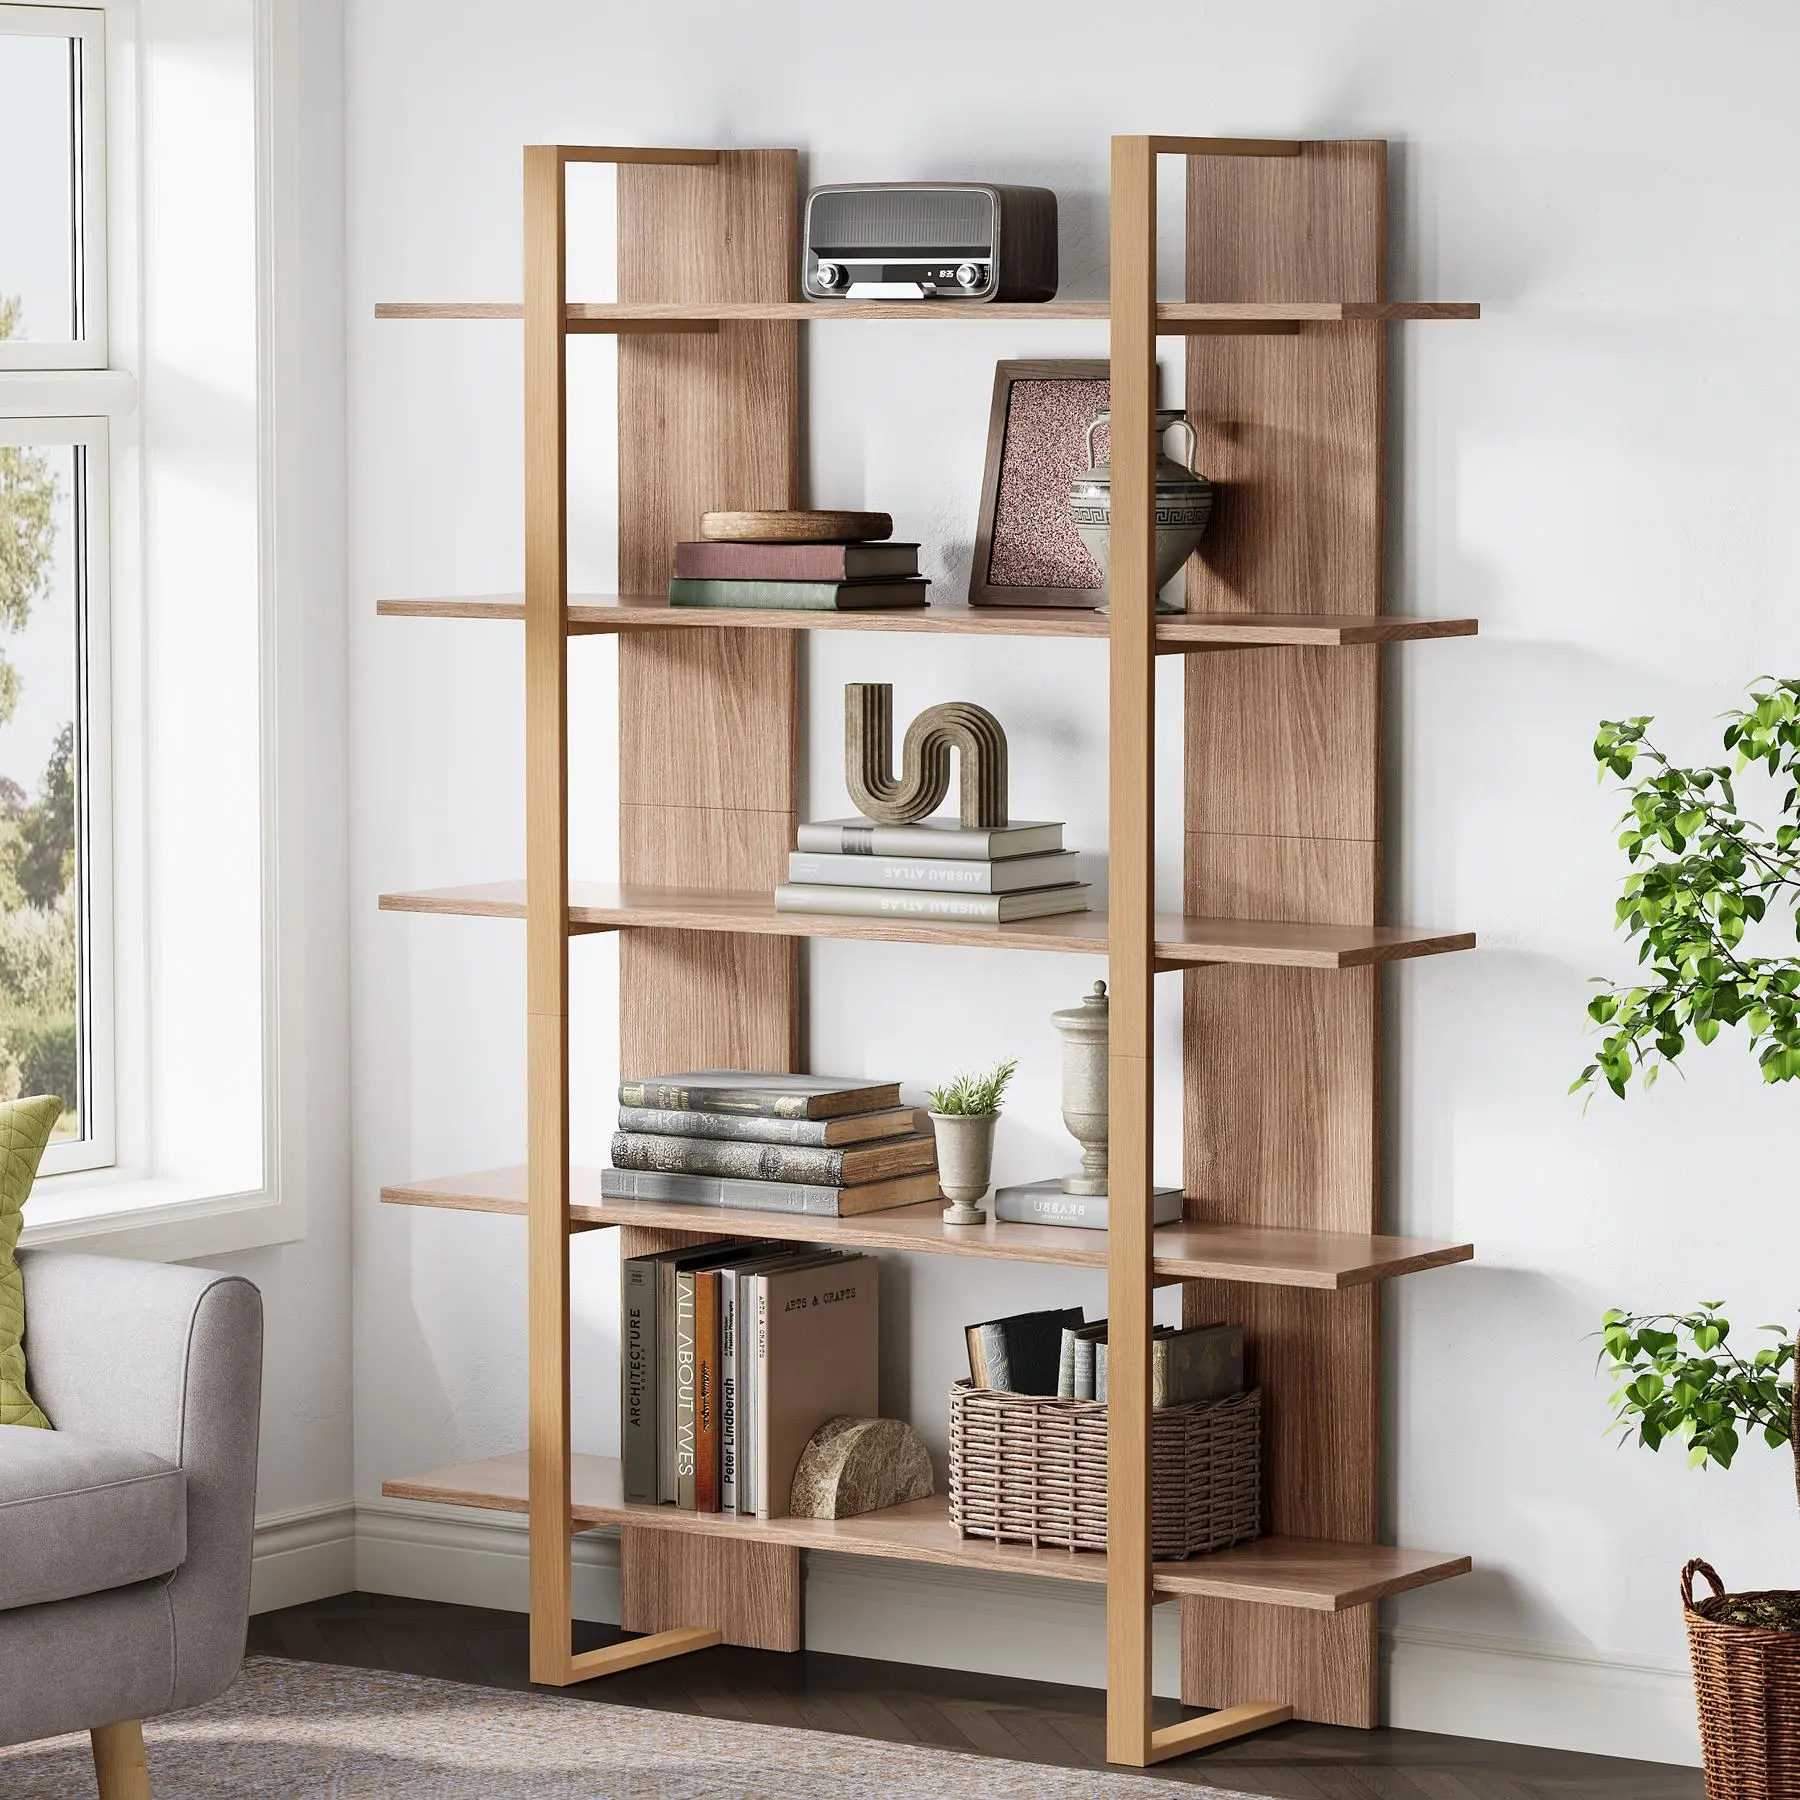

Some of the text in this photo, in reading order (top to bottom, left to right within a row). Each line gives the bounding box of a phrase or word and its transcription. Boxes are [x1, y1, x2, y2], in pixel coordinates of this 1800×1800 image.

[880, 898, 989, 915] AUSBAU ATLAS
[884, 866, 983, 883] AUSBAU ATLAS
[784, 1287, 856, 1312] ARTS & CRAFTS
[629, 1308, 641, 1427] ARCHITECTURE
[678, 1282, 694, 1476] ALL ABOUT YVES
[724, 1378, 735, 1484] Peter Lindbergh
